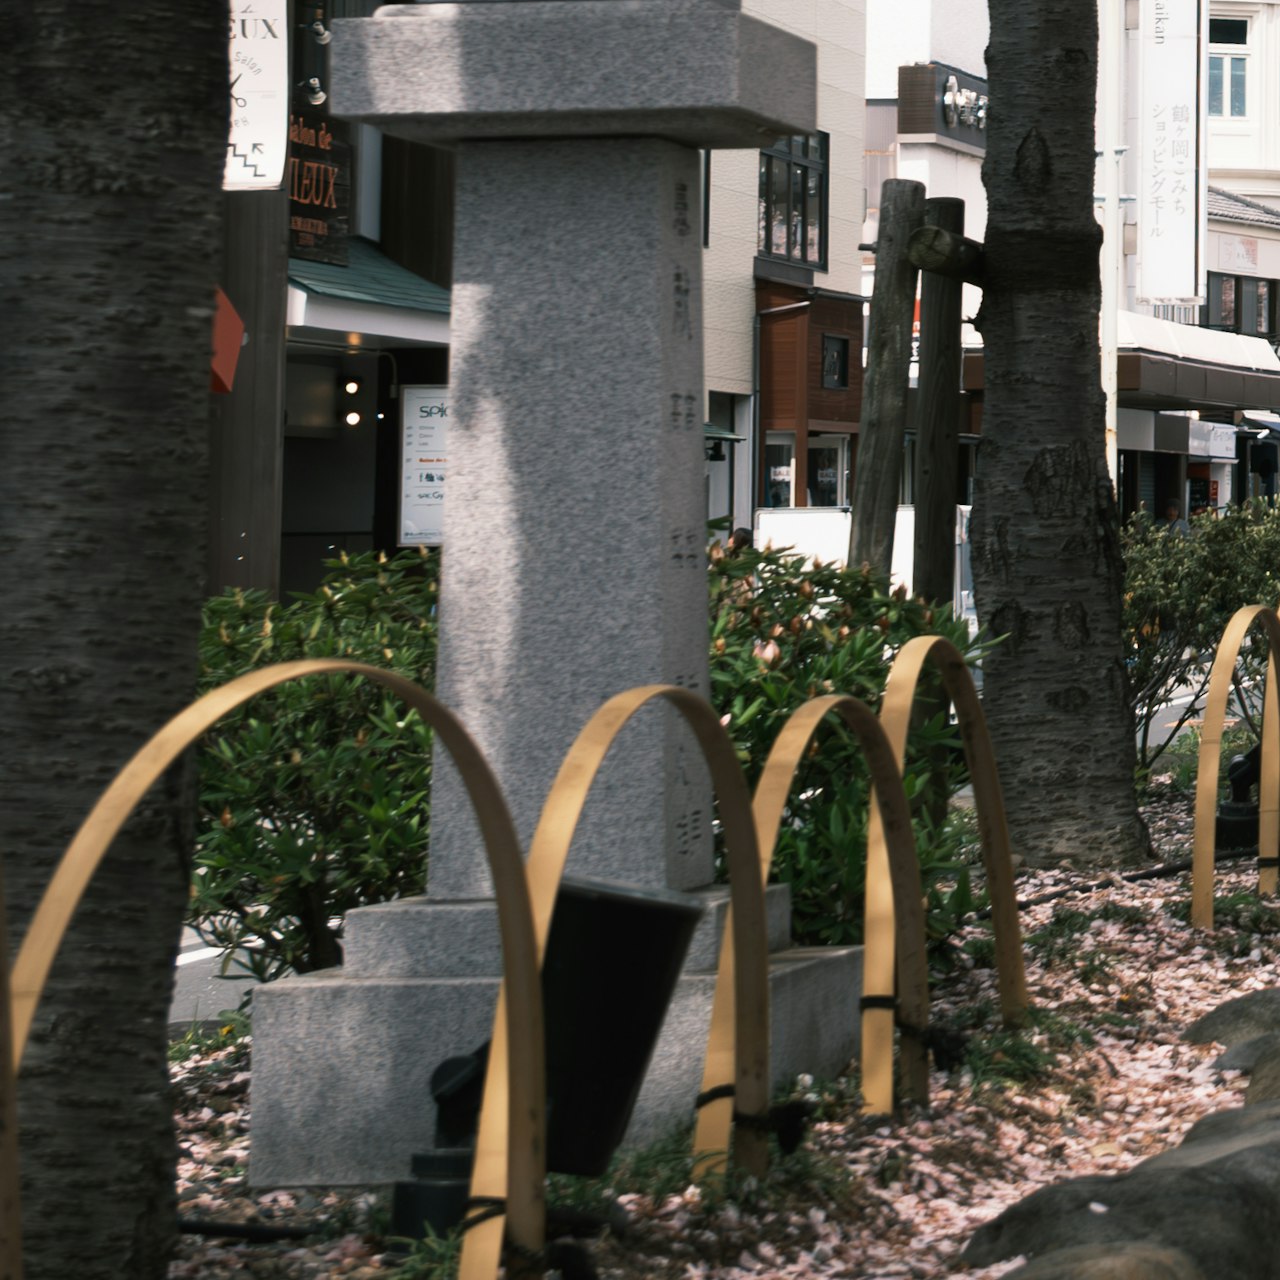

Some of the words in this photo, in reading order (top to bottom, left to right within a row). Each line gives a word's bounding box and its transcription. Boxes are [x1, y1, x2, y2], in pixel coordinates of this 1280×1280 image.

[233, 50, 263, 76] Salon
[1149, 103, 1167, 238] ショッピングモール
